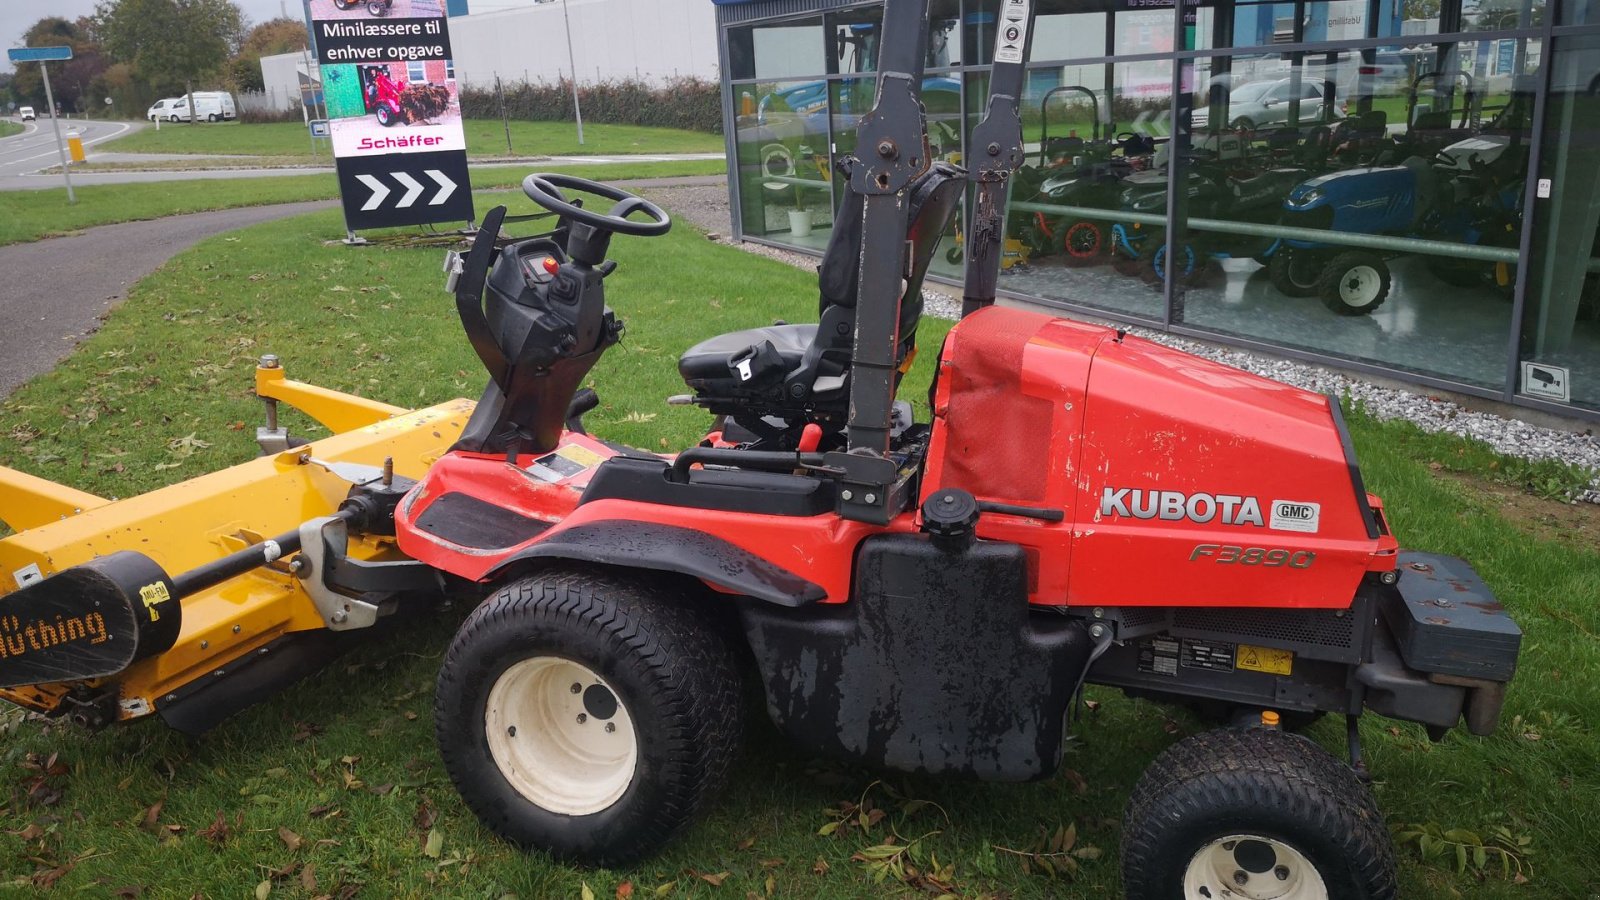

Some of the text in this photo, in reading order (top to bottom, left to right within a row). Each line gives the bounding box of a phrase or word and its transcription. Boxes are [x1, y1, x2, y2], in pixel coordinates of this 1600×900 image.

[323, 20, 441, 38] Minilæssere til
[327, 45, 444, 61] enhver opgave
[357, 135, 444, 150] Schäffer
[1101, 486, 1265, 527] KUBOTA
[1281, 505, 1310, 519] GMC
[1188, 543, 1318, 569] F3890
[143, 585, 168, 601] MU-FM
